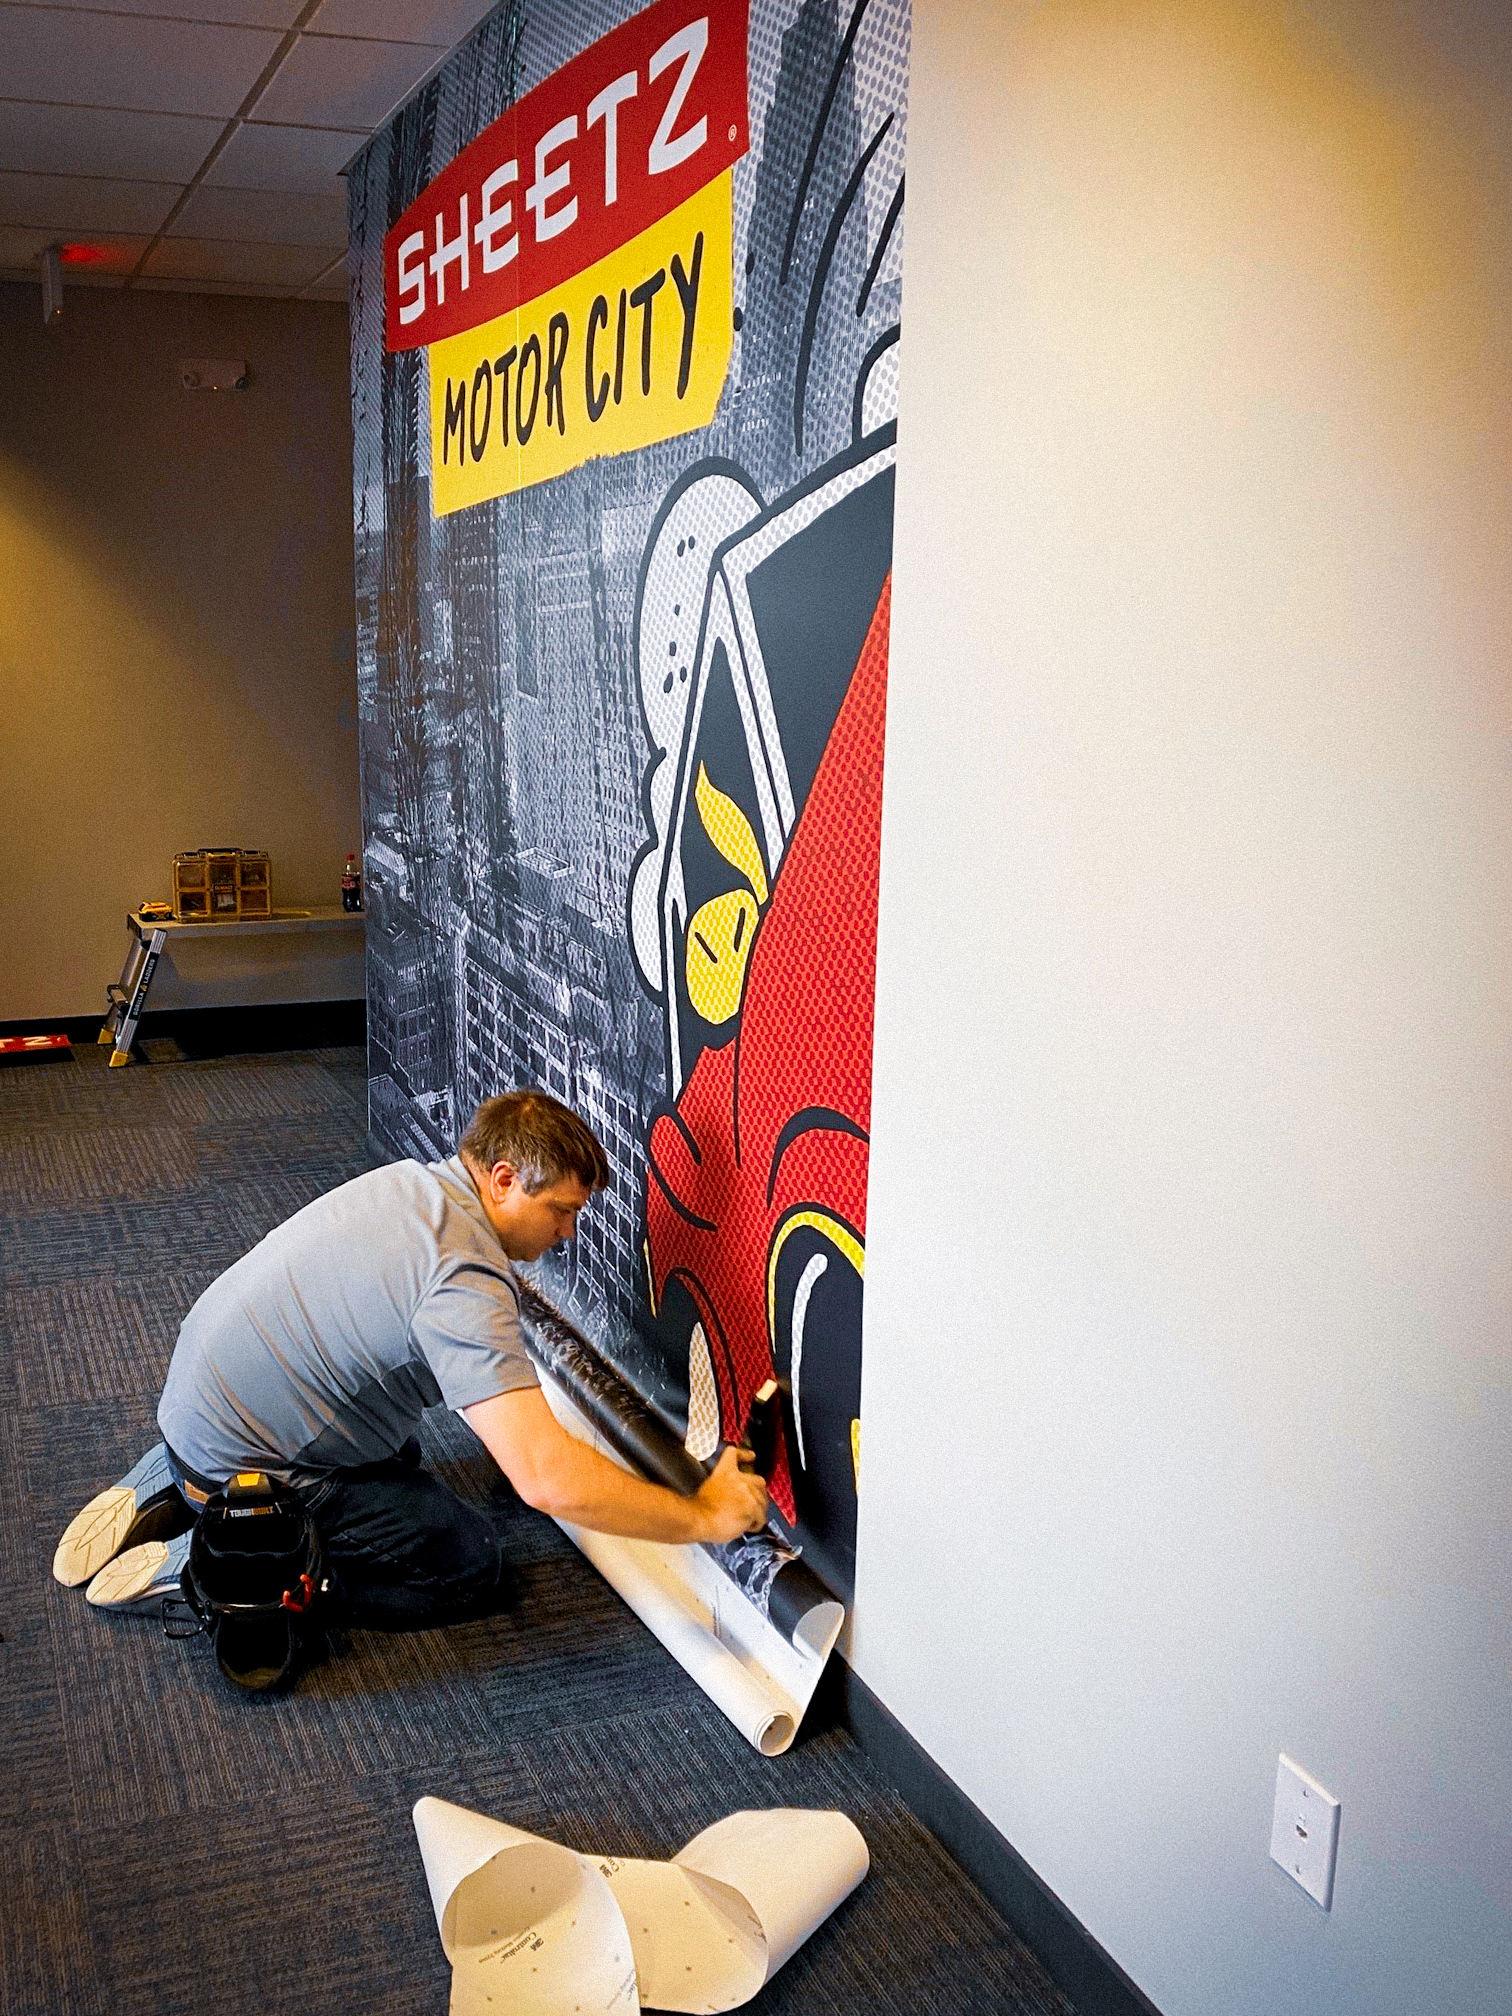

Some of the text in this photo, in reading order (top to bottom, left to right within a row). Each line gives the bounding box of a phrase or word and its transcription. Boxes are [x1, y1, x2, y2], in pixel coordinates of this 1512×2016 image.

[399, 17, 709, 325] SHEETZ
[443, 231, 704, 467] MOTOR CITY
